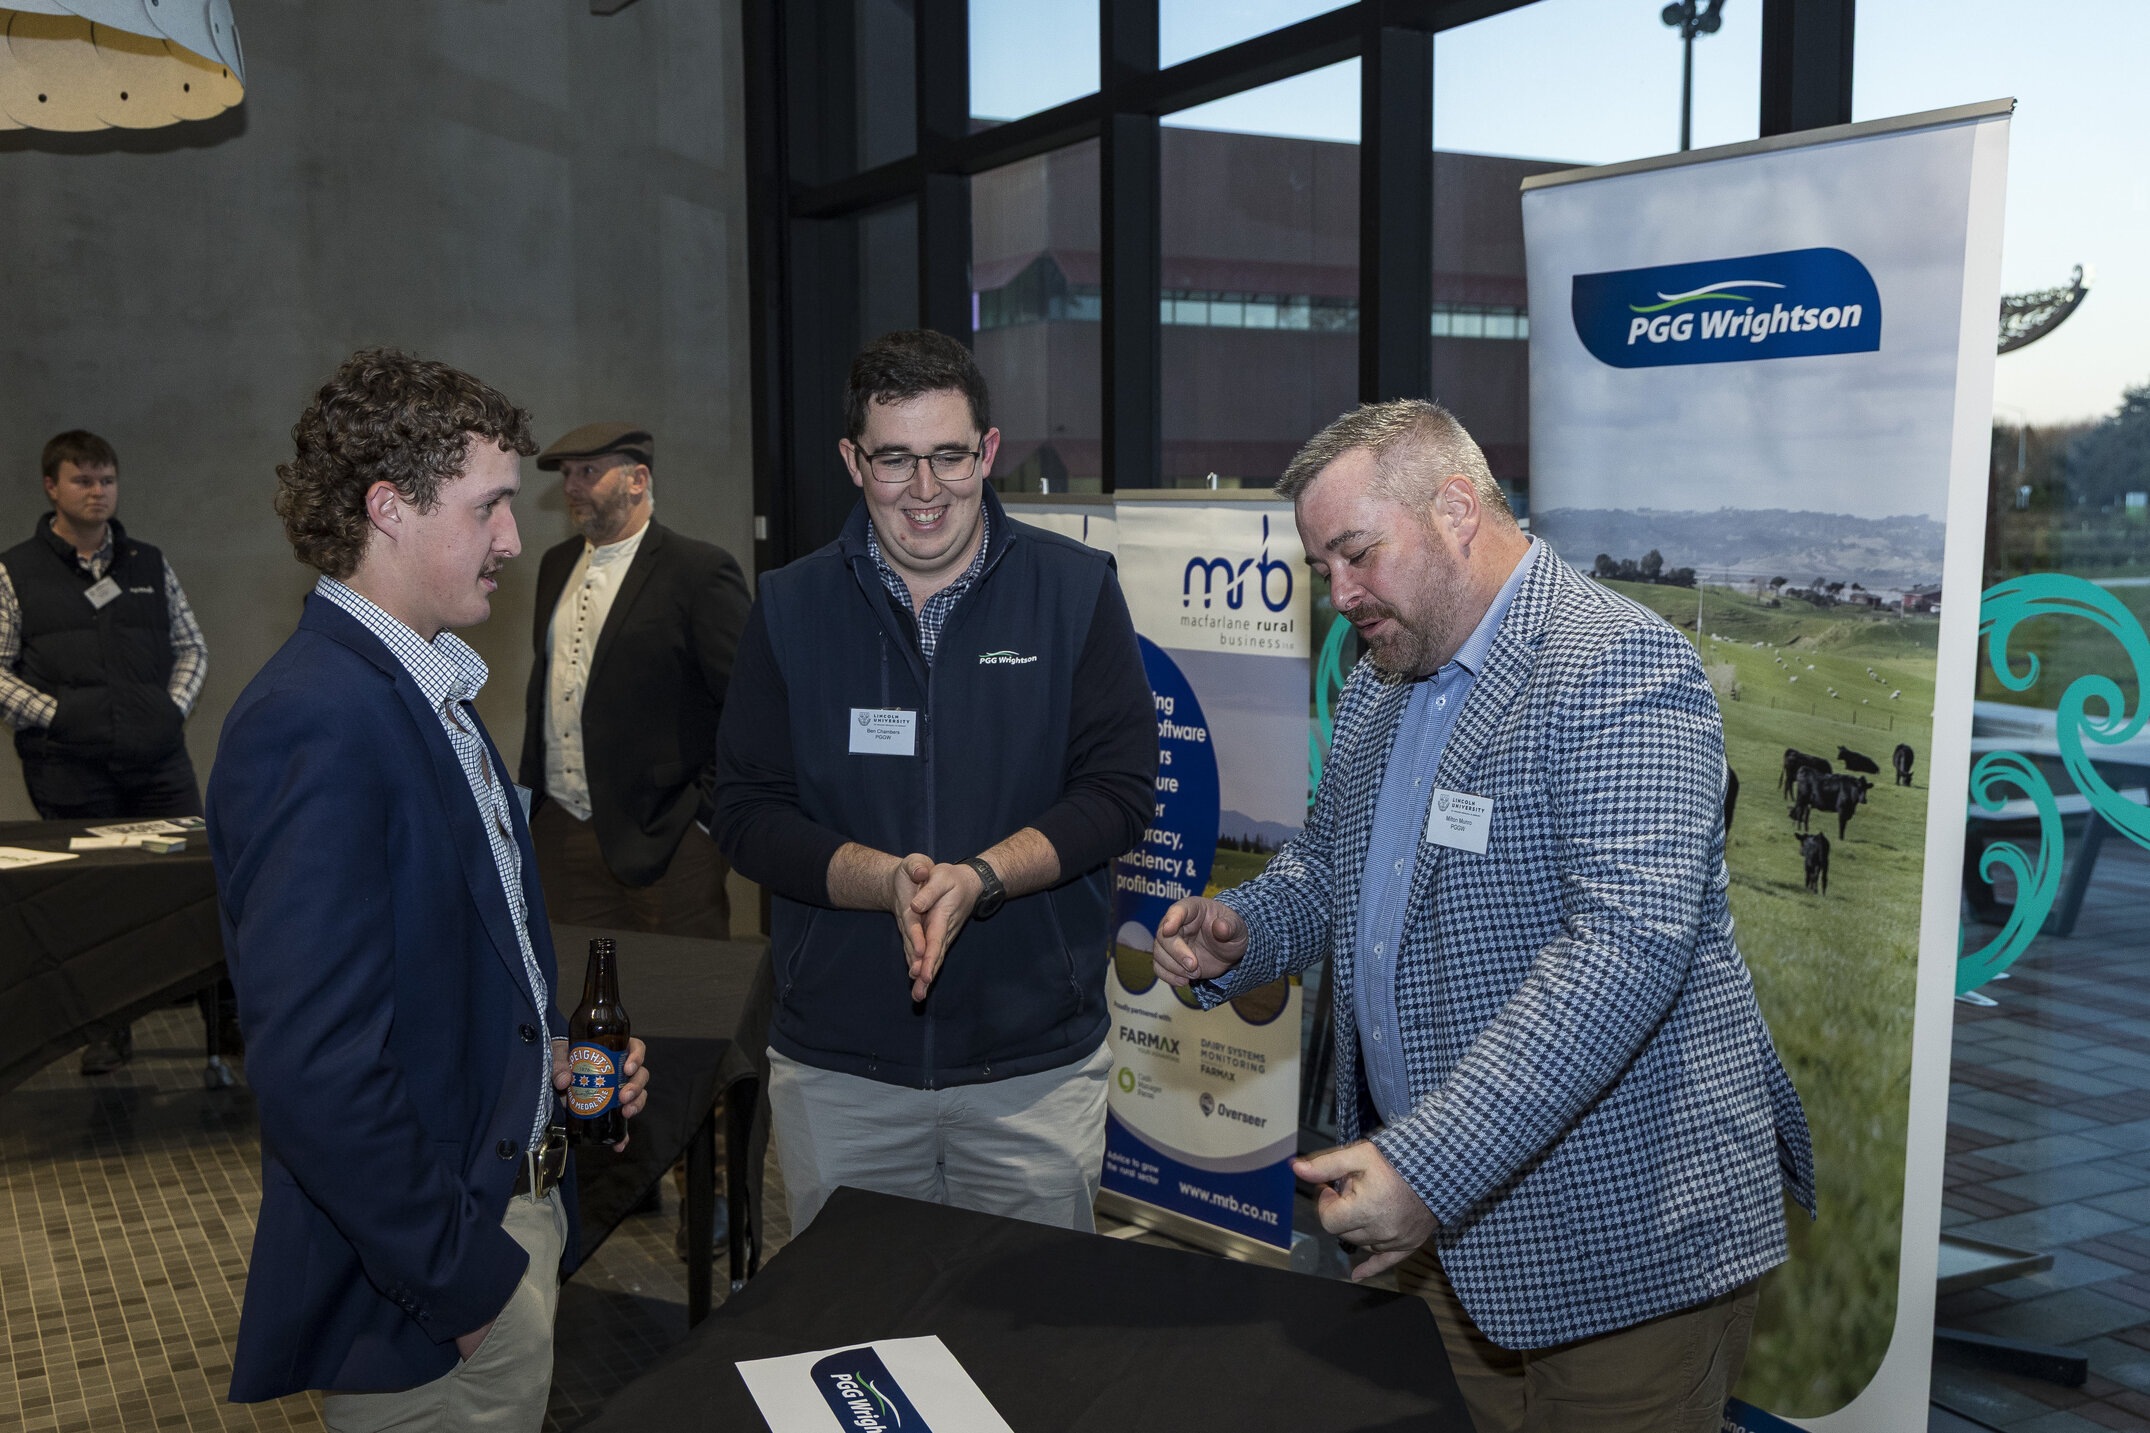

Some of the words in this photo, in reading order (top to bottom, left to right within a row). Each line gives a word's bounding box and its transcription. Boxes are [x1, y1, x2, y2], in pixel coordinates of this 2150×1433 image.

[1627, 313, 1694, 345] PGG
[1701, 303, 1862, 343] Wrightson
[1183, 514, 1293, 613] mrb
[1180, 614, 1250, 630] macfarlane
[1257, 620, 1294, 632] rural
[1220, 633, 1280, 649] business
[998, 656, 1037, 665] Wrightson
[1153, 691, 1174, 716] ing
[1158, 722, 1207, 743] oftware
[1160, 750, 1172, 765] rs
[1156, 778, 1179, 793] ure
[1452, 804, 1485, 813] UNIVERSITY
[1143, 828, 1183, 851] racy,
[1186, 858, 1197, 877] &
[1116, 874, 1191, 900] profitability
[1120, 1025, 1180, 1055] FARMAX
[1201, 1038, 1225, 1051] DAIRY
[1228, 1046, 1266, 1063] SYSTEMS
[1201, 1050, 1266, 1074] MONITORING
[575, 1102, 598, 1110] MEDAL
[598, 1090, 608, 1104] ALE
[1218, 1103, 1267, 1128] Overseer
[1178, 1181, 1279, 1226] www.mrb.co.nz
[830, 1373, 865, 1398] PGG
[847, 1399, 888, 1433] Wrigh
